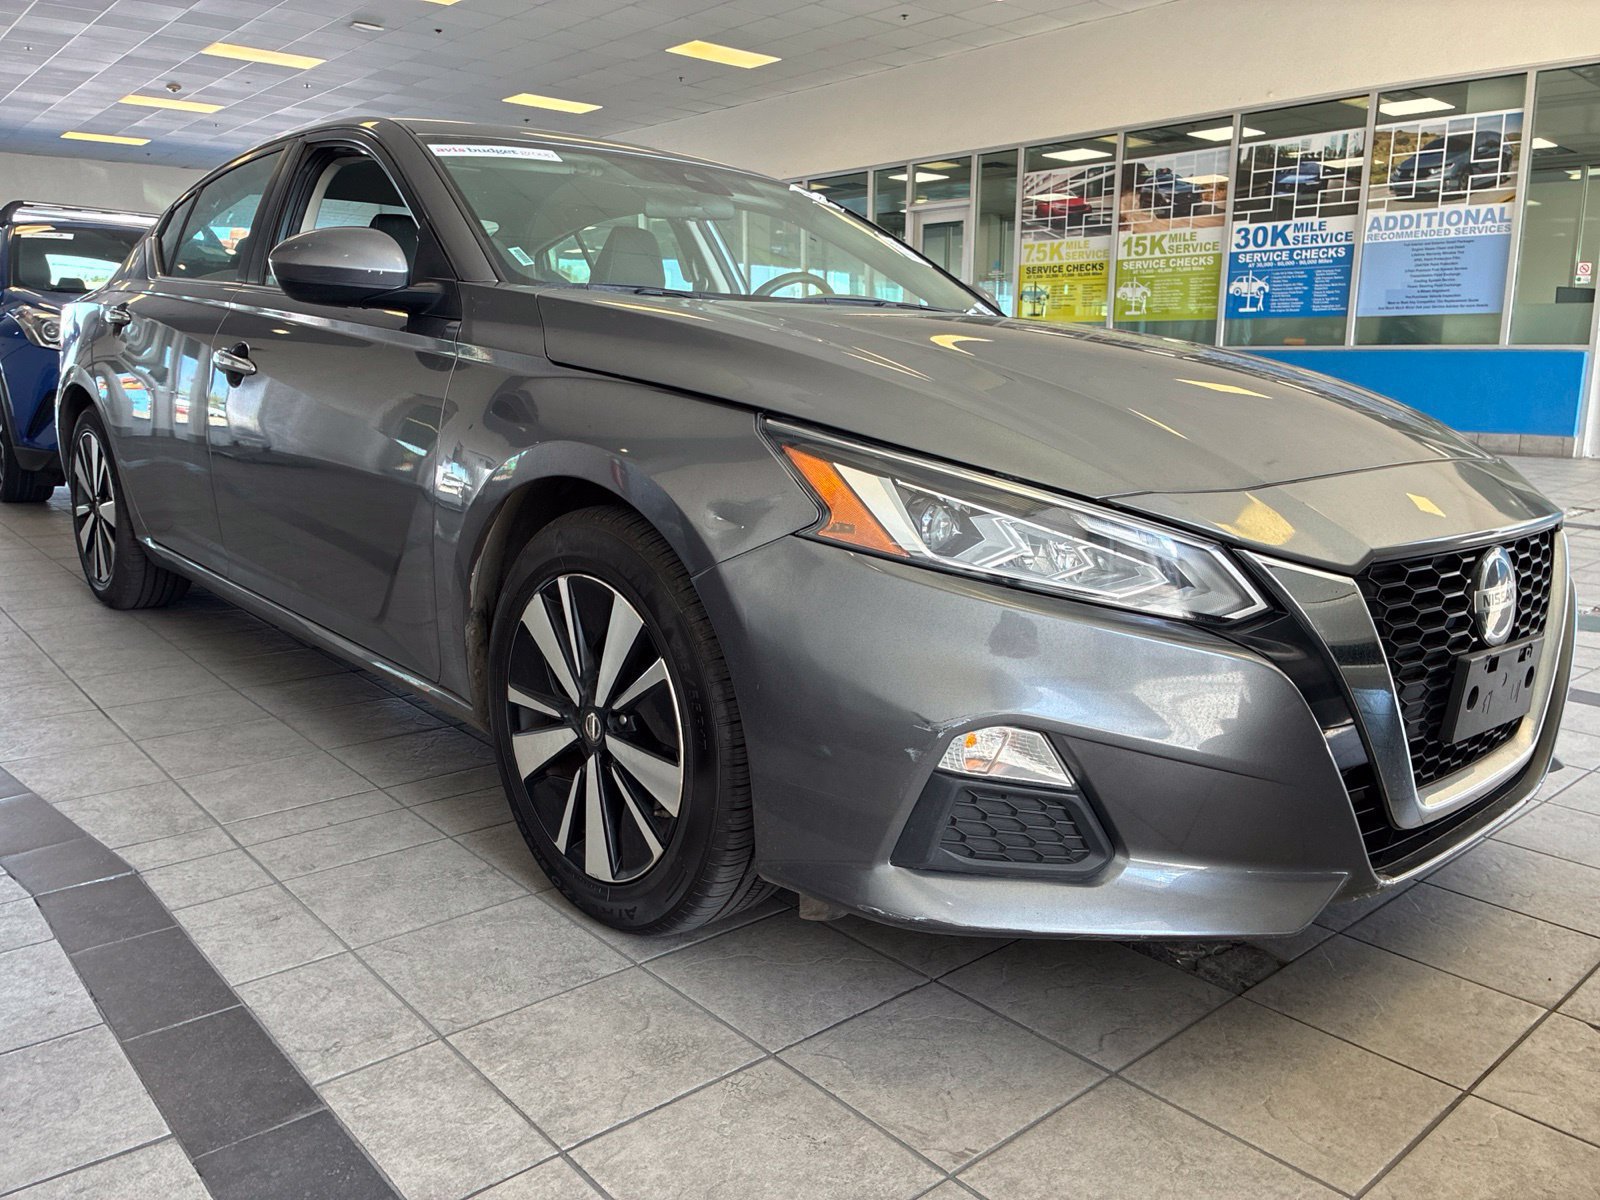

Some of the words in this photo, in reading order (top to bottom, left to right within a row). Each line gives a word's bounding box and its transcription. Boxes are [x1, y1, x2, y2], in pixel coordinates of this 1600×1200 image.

[1367, 207, 1512, 232] ADDITIONAL
[1293, 221, 1327, 233] MILE
[1366, 228, 1451, 241] RECOMMENDED
[1454, 224, 1512, 235] SERVICES
[1168, 232, 1197, 243] MILE
[1234, 223, 1292, 249] 30K
[1292, 231, 1354, 245] SERVICE
[1065, 240, 1089, 250] MILE
[1122, 234, 1168, 257] 15K
[1167, 241, 1220, 254] SERVICE
[1065, 249, 1110, 260] SERVICE
[1238, 251, 1290, 263] SERVICE
[1293, 247, 1346, 260] CHECKS
[1026, 265, 1064, 275] SERVICE
[1066, 262, 1104, 272] CHECKS
[1122, 259, 1167, 270] SERVICE
[1169, 256, 1214, 267] CHECKS
[1483, 588, 1513, 608] NISSAN
